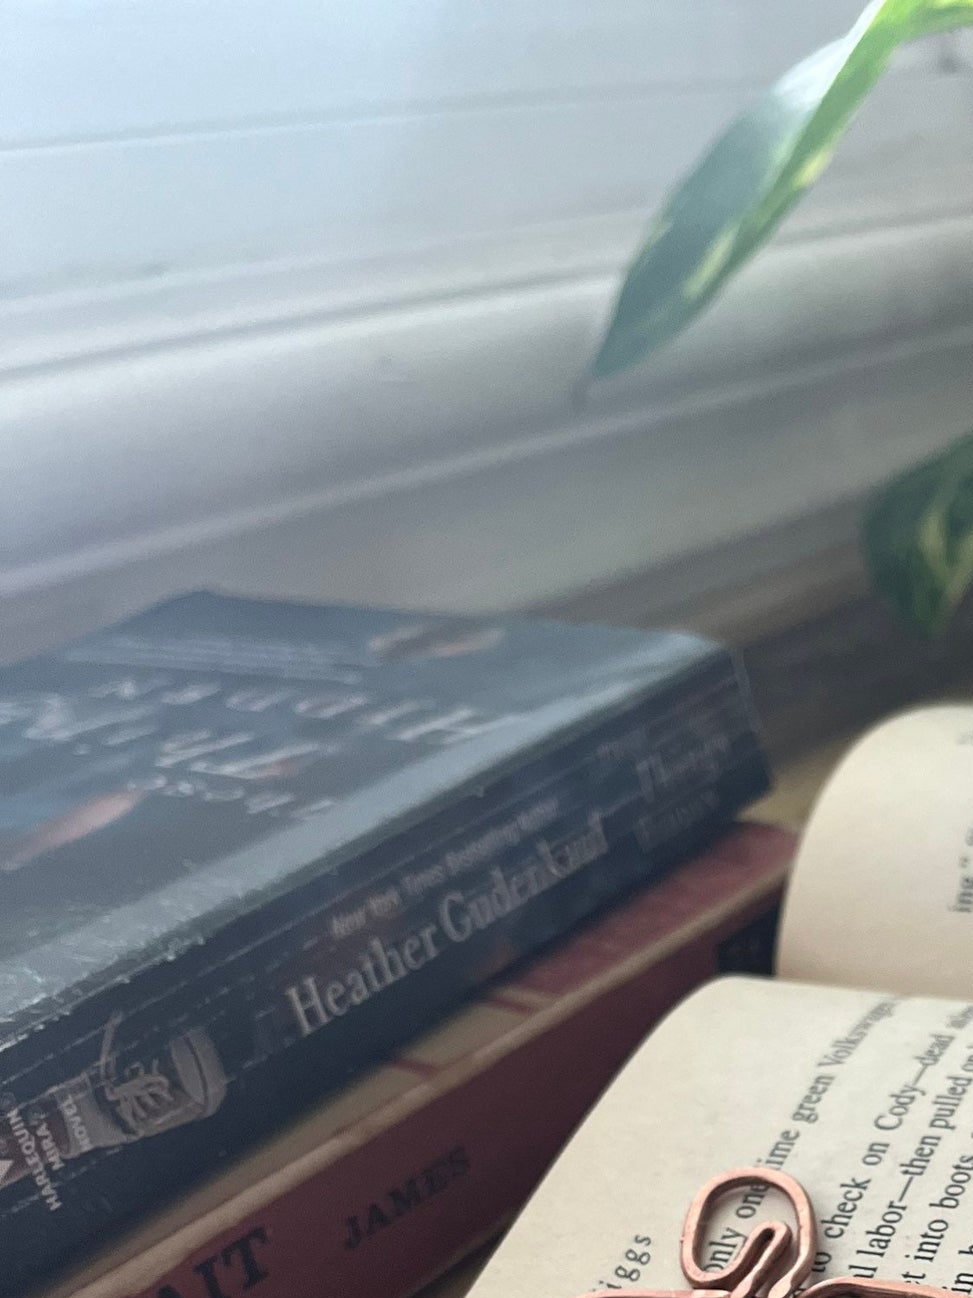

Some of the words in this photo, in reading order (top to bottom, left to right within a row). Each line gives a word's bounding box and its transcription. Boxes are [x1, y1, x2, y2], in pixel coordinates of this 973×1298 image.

[284, 922, 440, 1039] Heather
[790, 1074, 835, 1124] green
[927, 1075, 973, 1131] pulled
[7, 1108, 63, 1212] HARLEQUIN
[343, 1145, 471, 1249] JAMES
[823, 1178, 872, 1240] check
[861, 1141, 890, 1166] on
[904, 1218, 949, 1262] into
